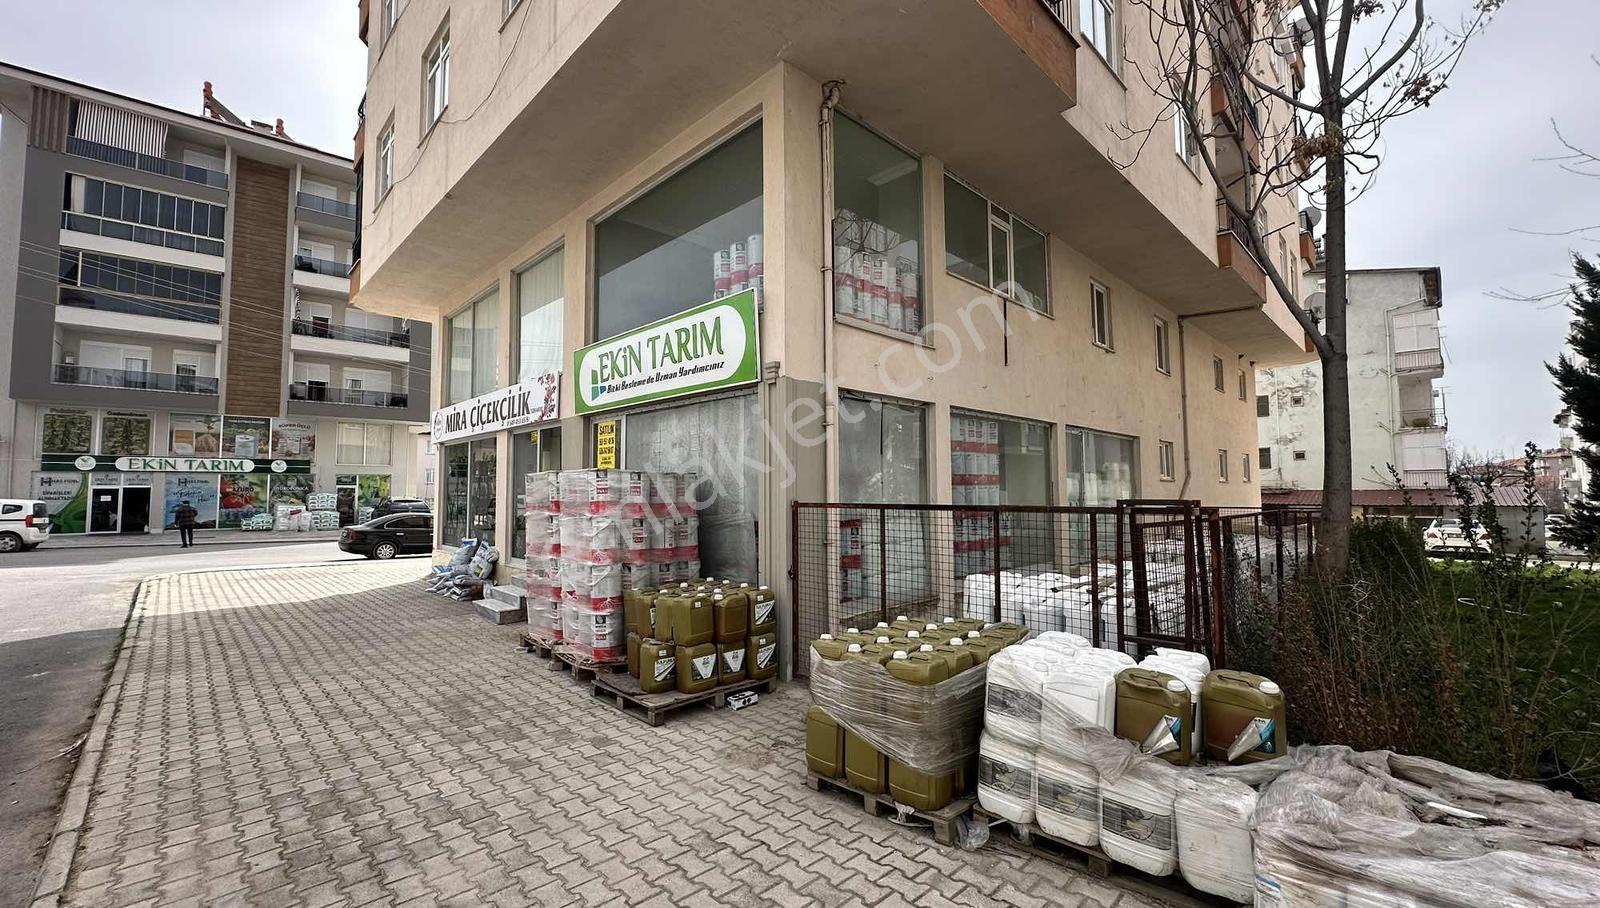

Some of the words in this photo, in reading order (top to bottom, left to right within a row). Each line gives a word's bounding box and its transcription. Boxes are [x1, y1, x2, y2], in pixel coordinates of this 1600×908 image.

[647, 316, 724, 370] TARIM
[606, 383, 621, 394] Bitki
[621, 379, 646, 391] Besleme
[646, 375, 655, 384] de
[654, 371, 677, 383] Uzman
[678, 361, 725, 379] Yardımcınız
[445, 407, 467, 433] MİRA
[470, 386, 531, 432] ÇİÇEKÇİLİK
[184, 459, 246, 471] TARIM
